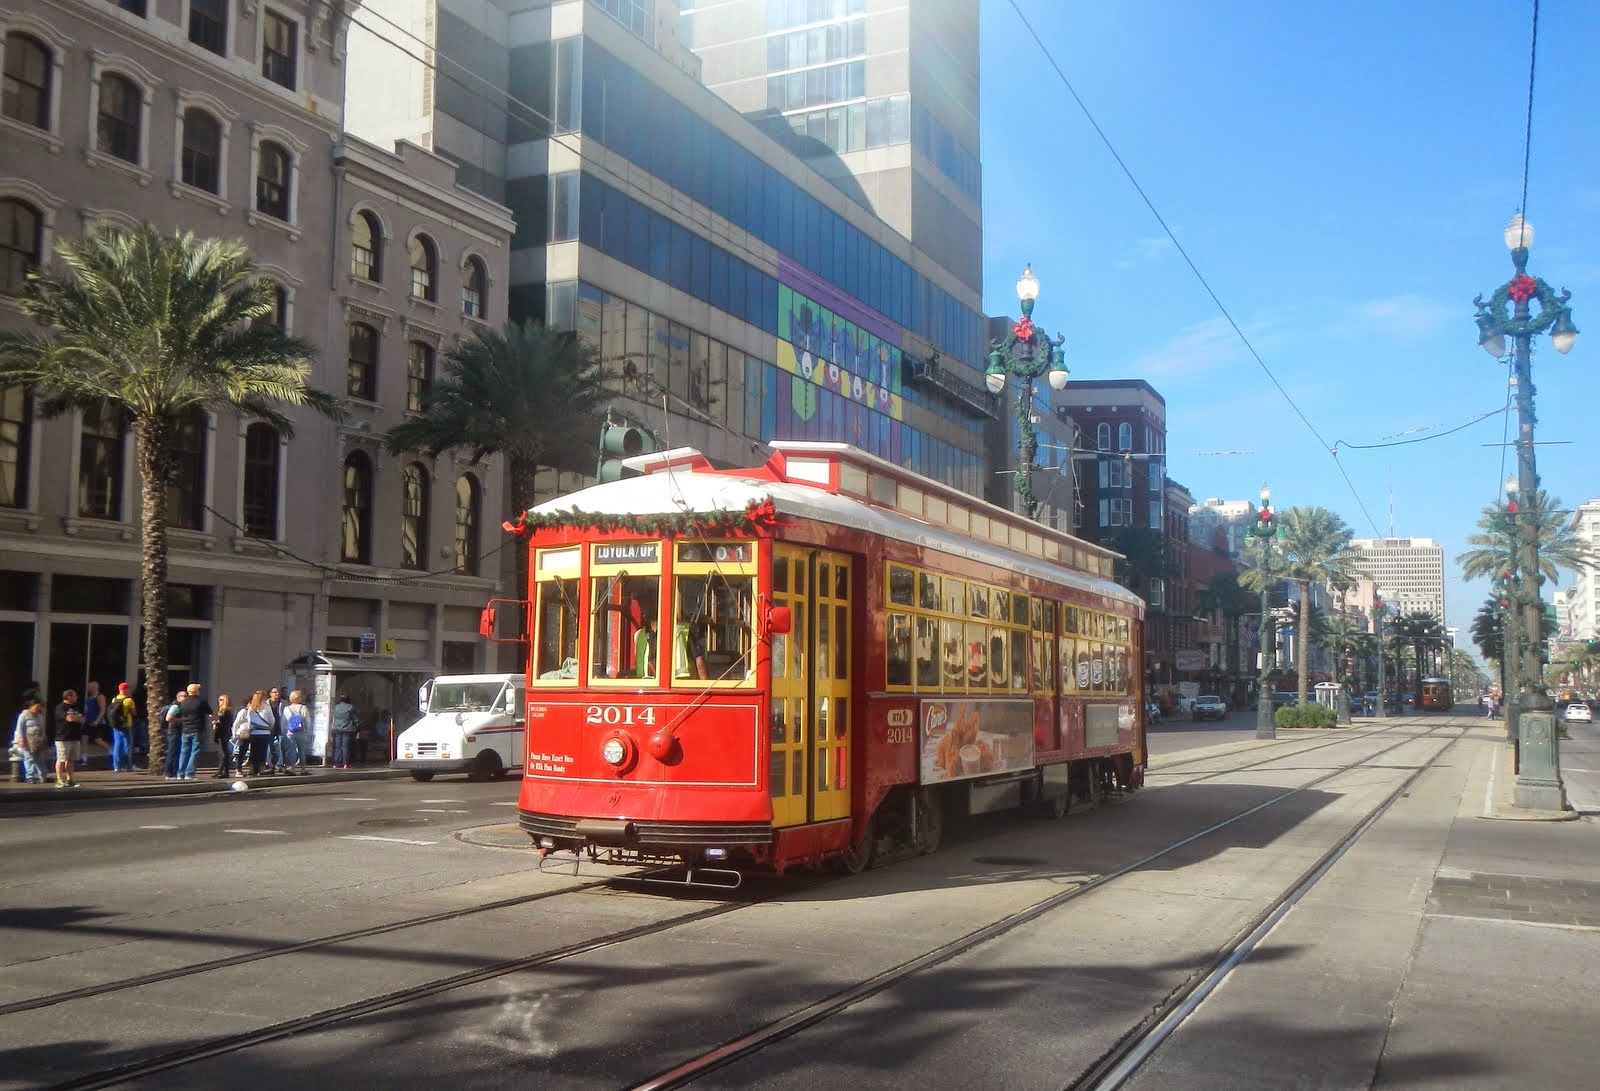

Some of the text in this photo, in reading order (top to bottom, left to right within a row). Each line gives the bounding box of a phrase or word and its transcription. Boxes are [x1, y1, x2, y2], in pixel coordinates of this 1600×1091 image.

[586, 706, 656, 725] 2014
[893, 712, 902, 722] RTA
[887, 727, 912, 744] 2014
